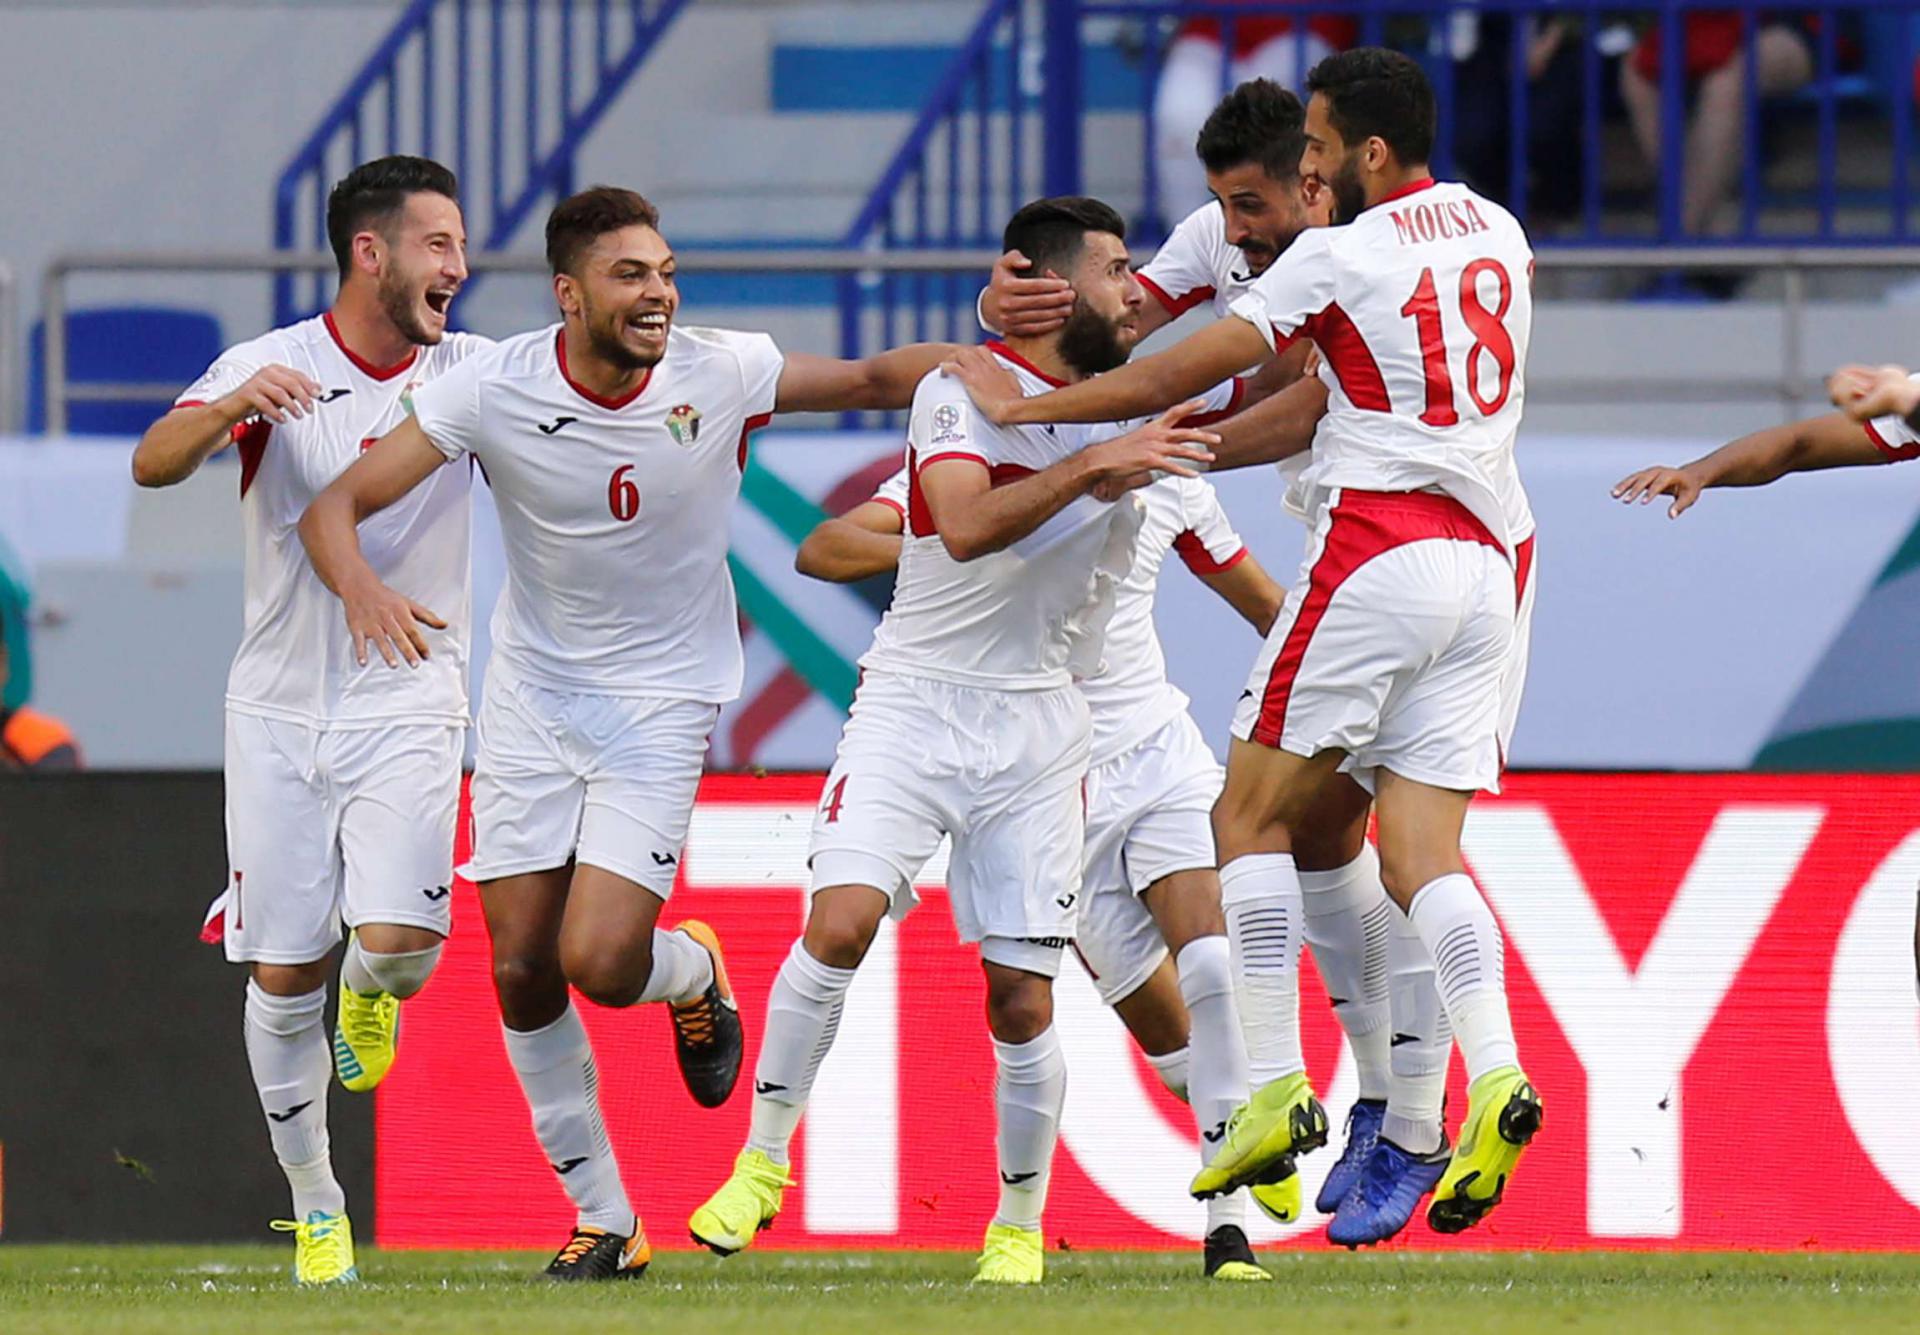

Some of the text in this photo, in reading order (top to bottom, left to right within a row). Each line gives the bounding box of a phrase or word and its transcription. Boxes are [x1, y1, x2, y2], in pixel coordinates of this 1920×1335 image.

[1389, 199, 1490, 245] MOUSA
[1400, 257, 1515, 427] 18
[608, 464, 640, 522] 6
[821, 773, 849, 824] 4
[335, 1023, 364, 1081] MA
